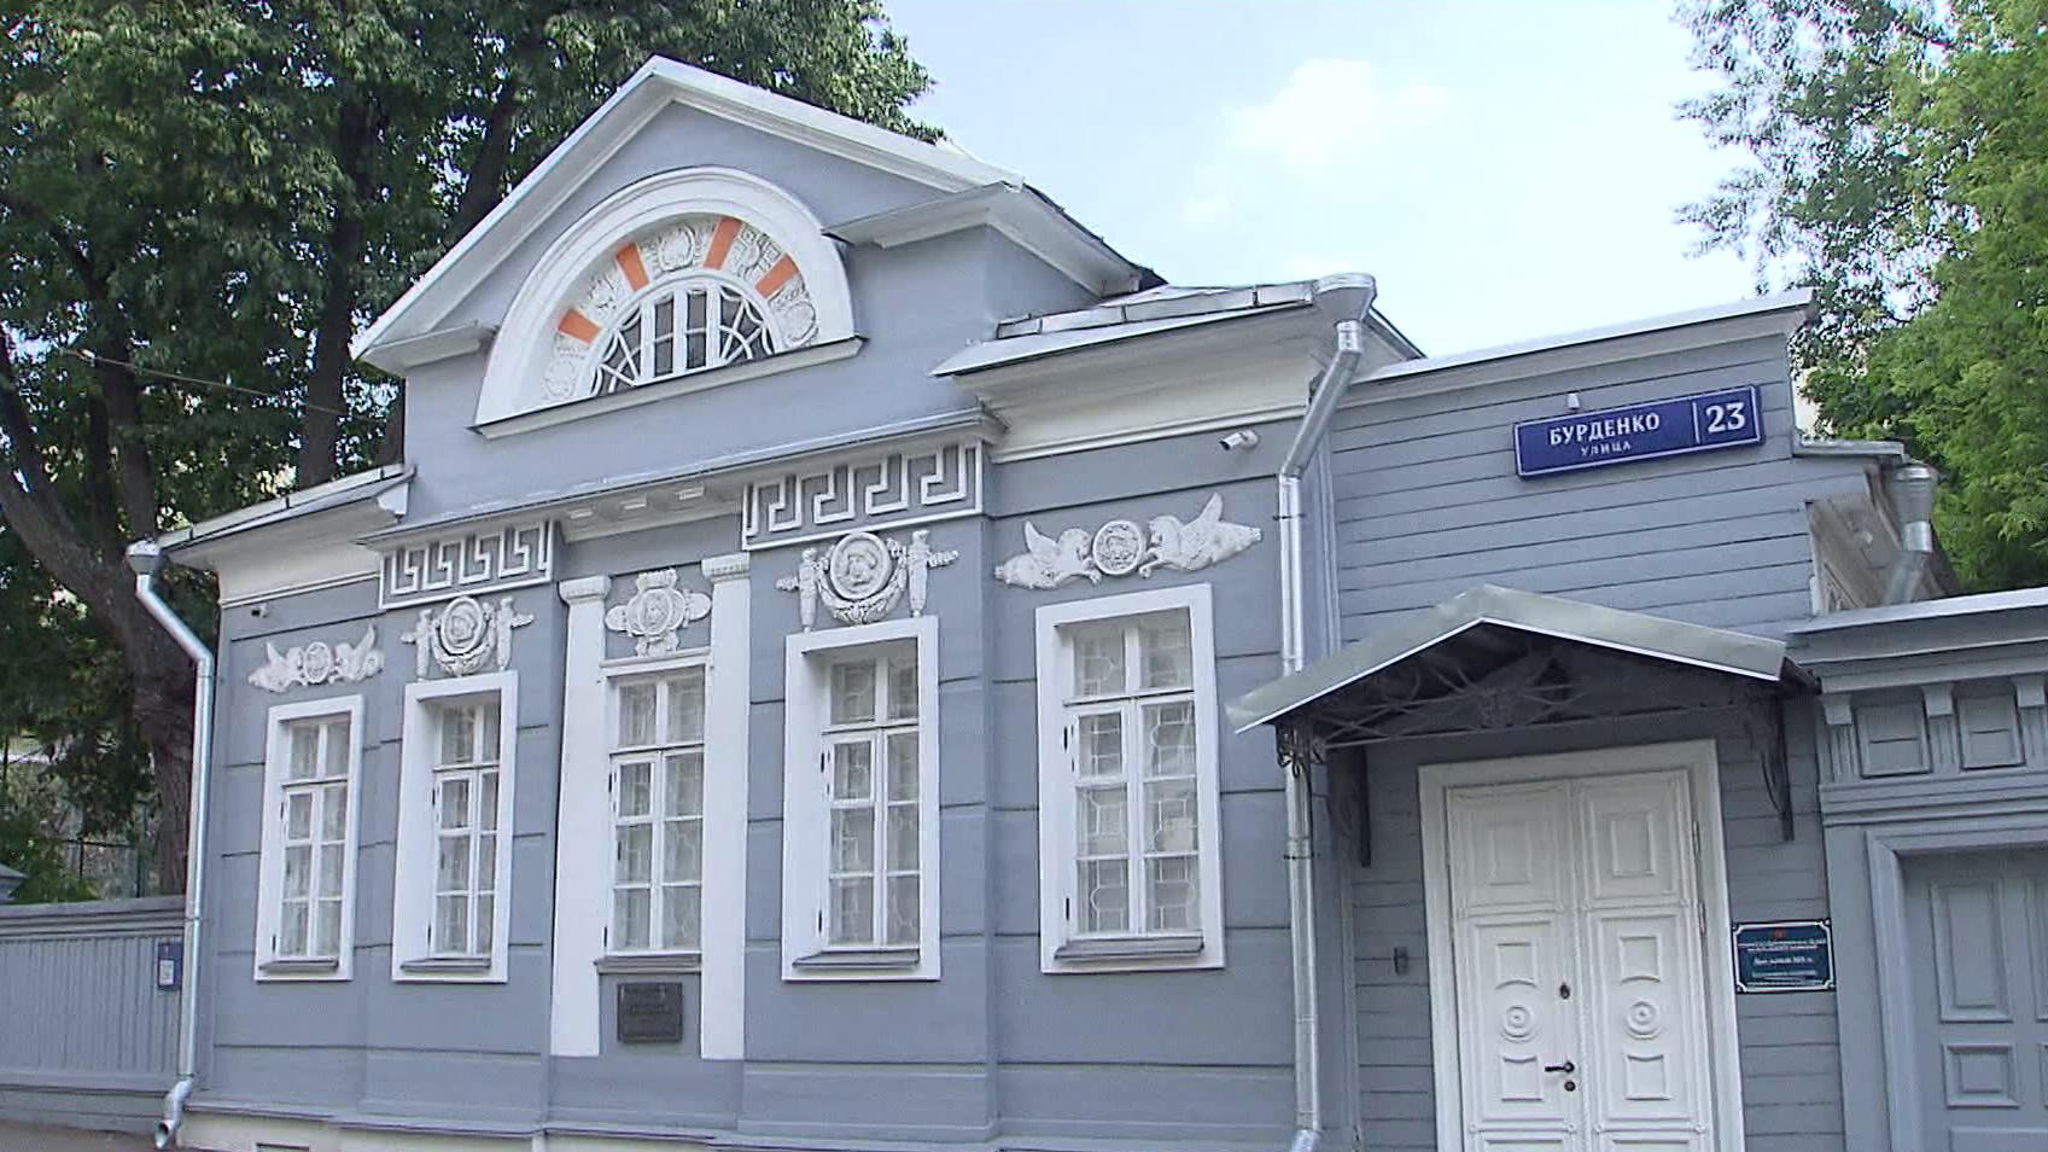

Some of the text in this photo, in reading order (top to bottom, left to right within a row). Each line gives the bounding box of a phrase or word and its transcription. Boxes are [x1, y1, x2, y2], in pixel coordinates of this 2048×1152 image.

[1549, 412, 1660, 446] БУРДЕНКО
[1706, 402, 1746, 433] 23
[1581, 442, 1632, 457] УЛИЦА
